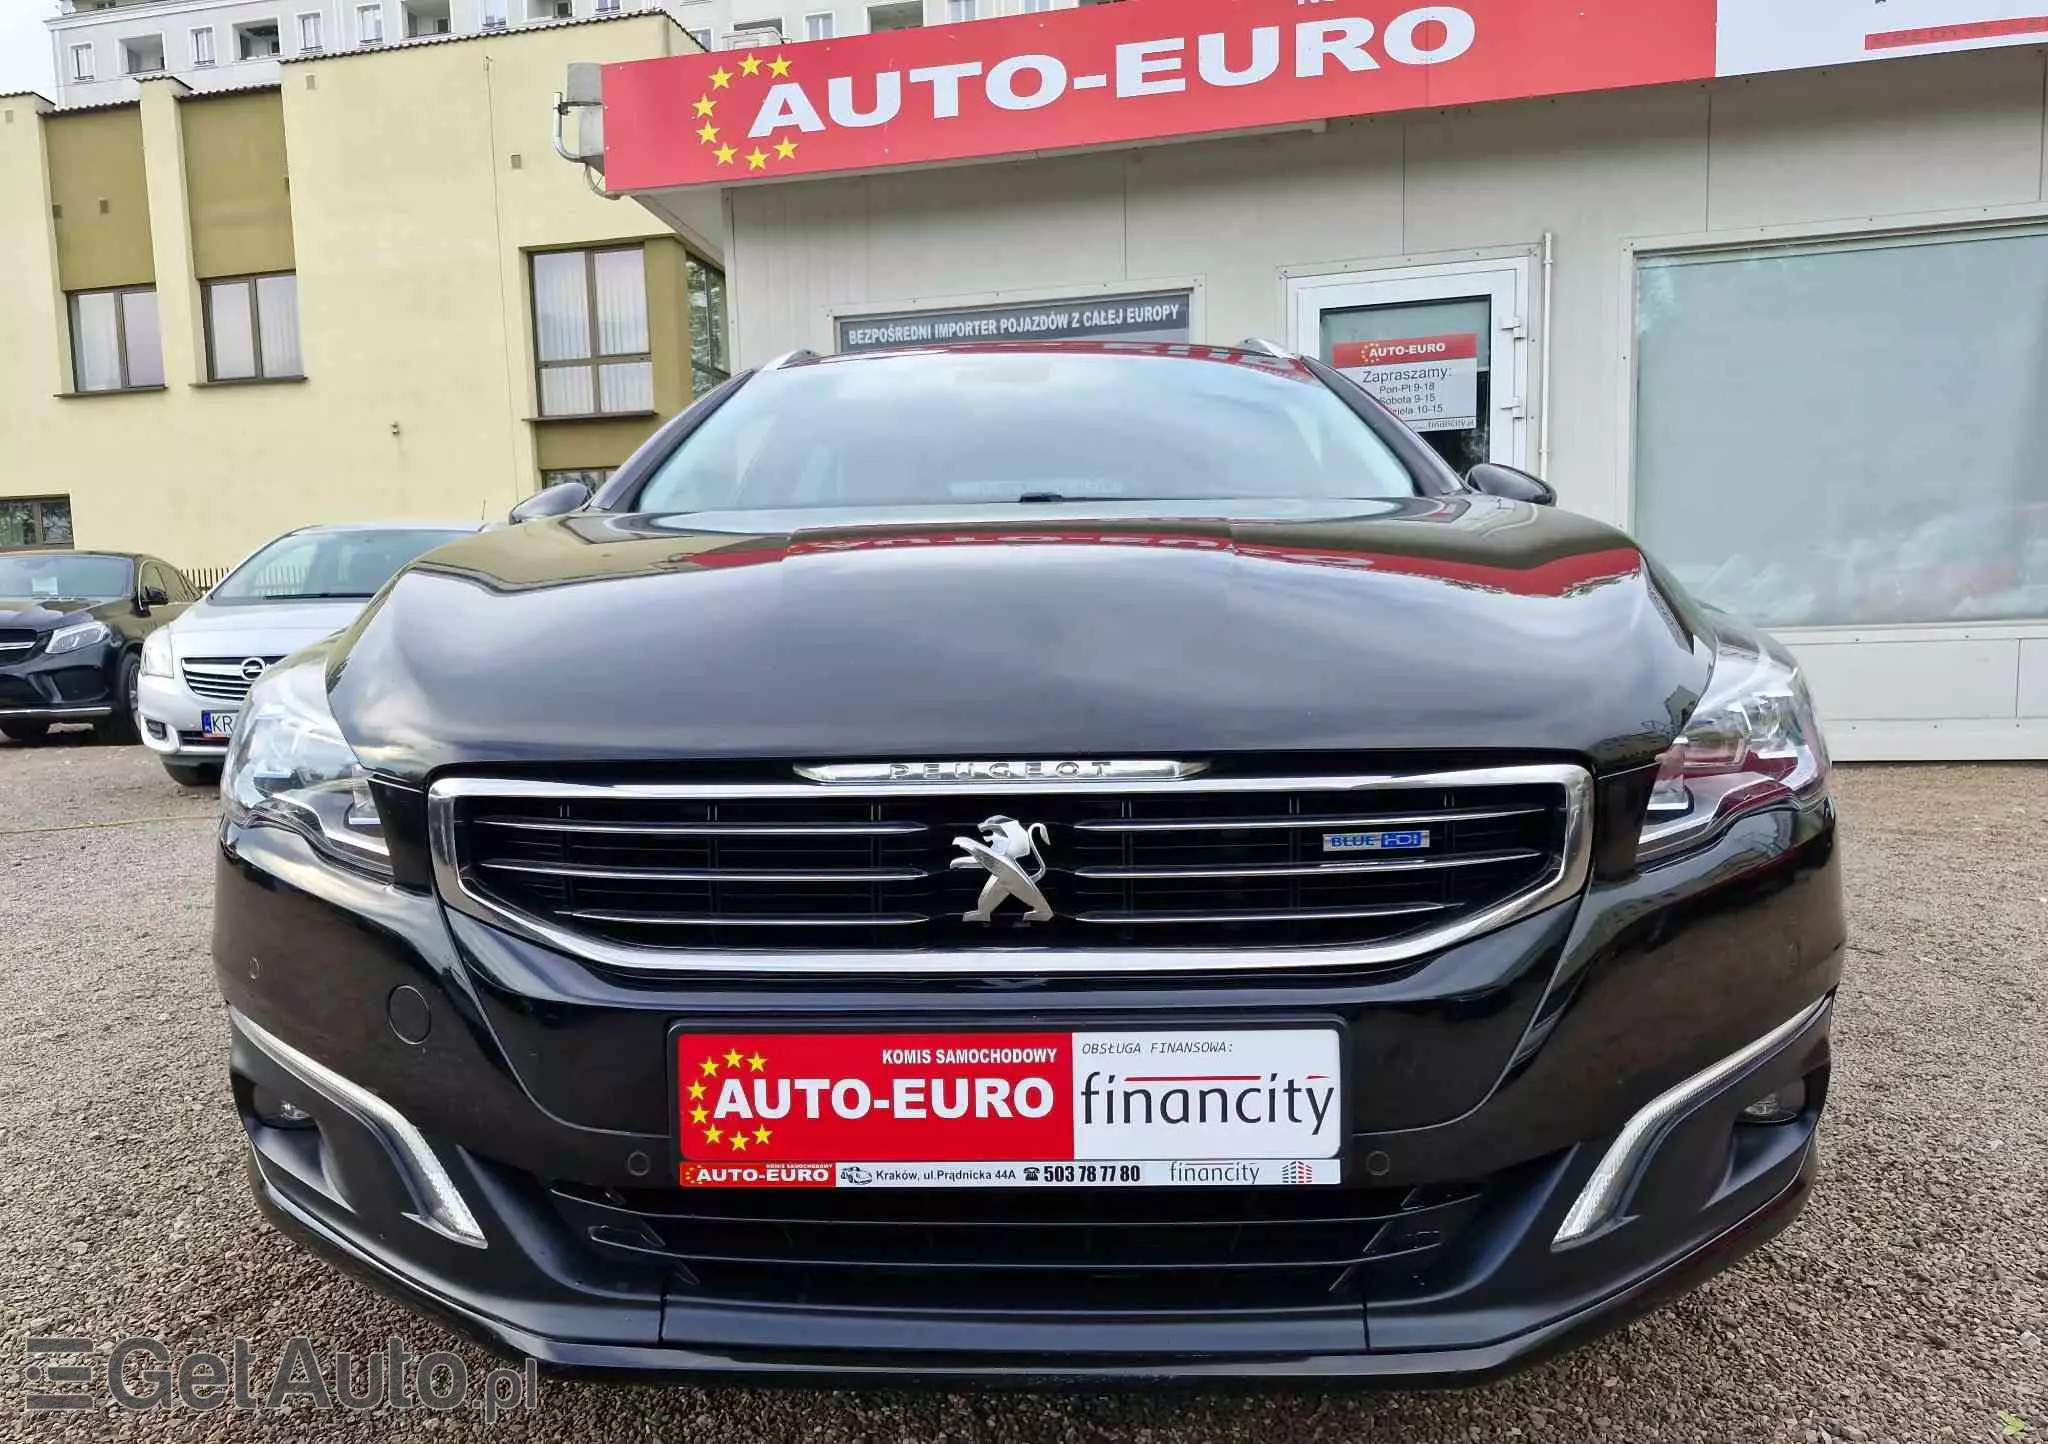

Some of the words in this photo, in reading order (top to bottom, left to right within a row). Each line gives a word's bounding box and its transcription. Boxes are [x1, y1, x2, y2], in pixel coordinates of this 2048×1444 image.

[747, 6, 1475, 138] AUTO-EURO
[848, 324, 932, 345] BEZPOŚREDNI
[934, 319, 997, 339] IMPORTER
[1000, 311, 1068, 334] POJAZDÓW
[1071, 312, 1080, 328] Z
[1083, 308, 1124, 327] CAŁEJ
[1126, 304, 1179, 324] EUROPY
[1369, 342, 1445, 358] AUTO-EURO
[1362, 367, 1452, 384] Zapraszamy:
[1413, 382, 1435, 392] 9-18
[1379, 396, 1412, 405] Sobota
[1417, 404, 1443, 414] 10-15
[889, 761, 1111, 779] PEUGEOT
[1331, 835, 1376, 847] BLUE
[882, 1048, 931, 1064] KOMIS
[935, 1047, 1057, 1064] SAMOCHODOWY
[1082, 1042, 1142, 1055] OBSŁUGA
[1150, 1041, 1233, 1054] FINANSOWA:
[712, 1077, 1054, 1120] AUTO-EURO
[1080, 1070, 1335, 1136] financity
[696, 1168, 829, 1182] AUTO-EURO
[875, 1169, 920, 1181] Kraków,
[994, 1169, 1016, 1180] 44A
[1043, 1165, 1075, 1183] 503
[1077, 1164, 1097, 1182] 78
[1099, 1165, 1119, 1182] 77
[1119, 1164, 1141, 1182] 80
[1169, 1161, 1260, 1184] financity
